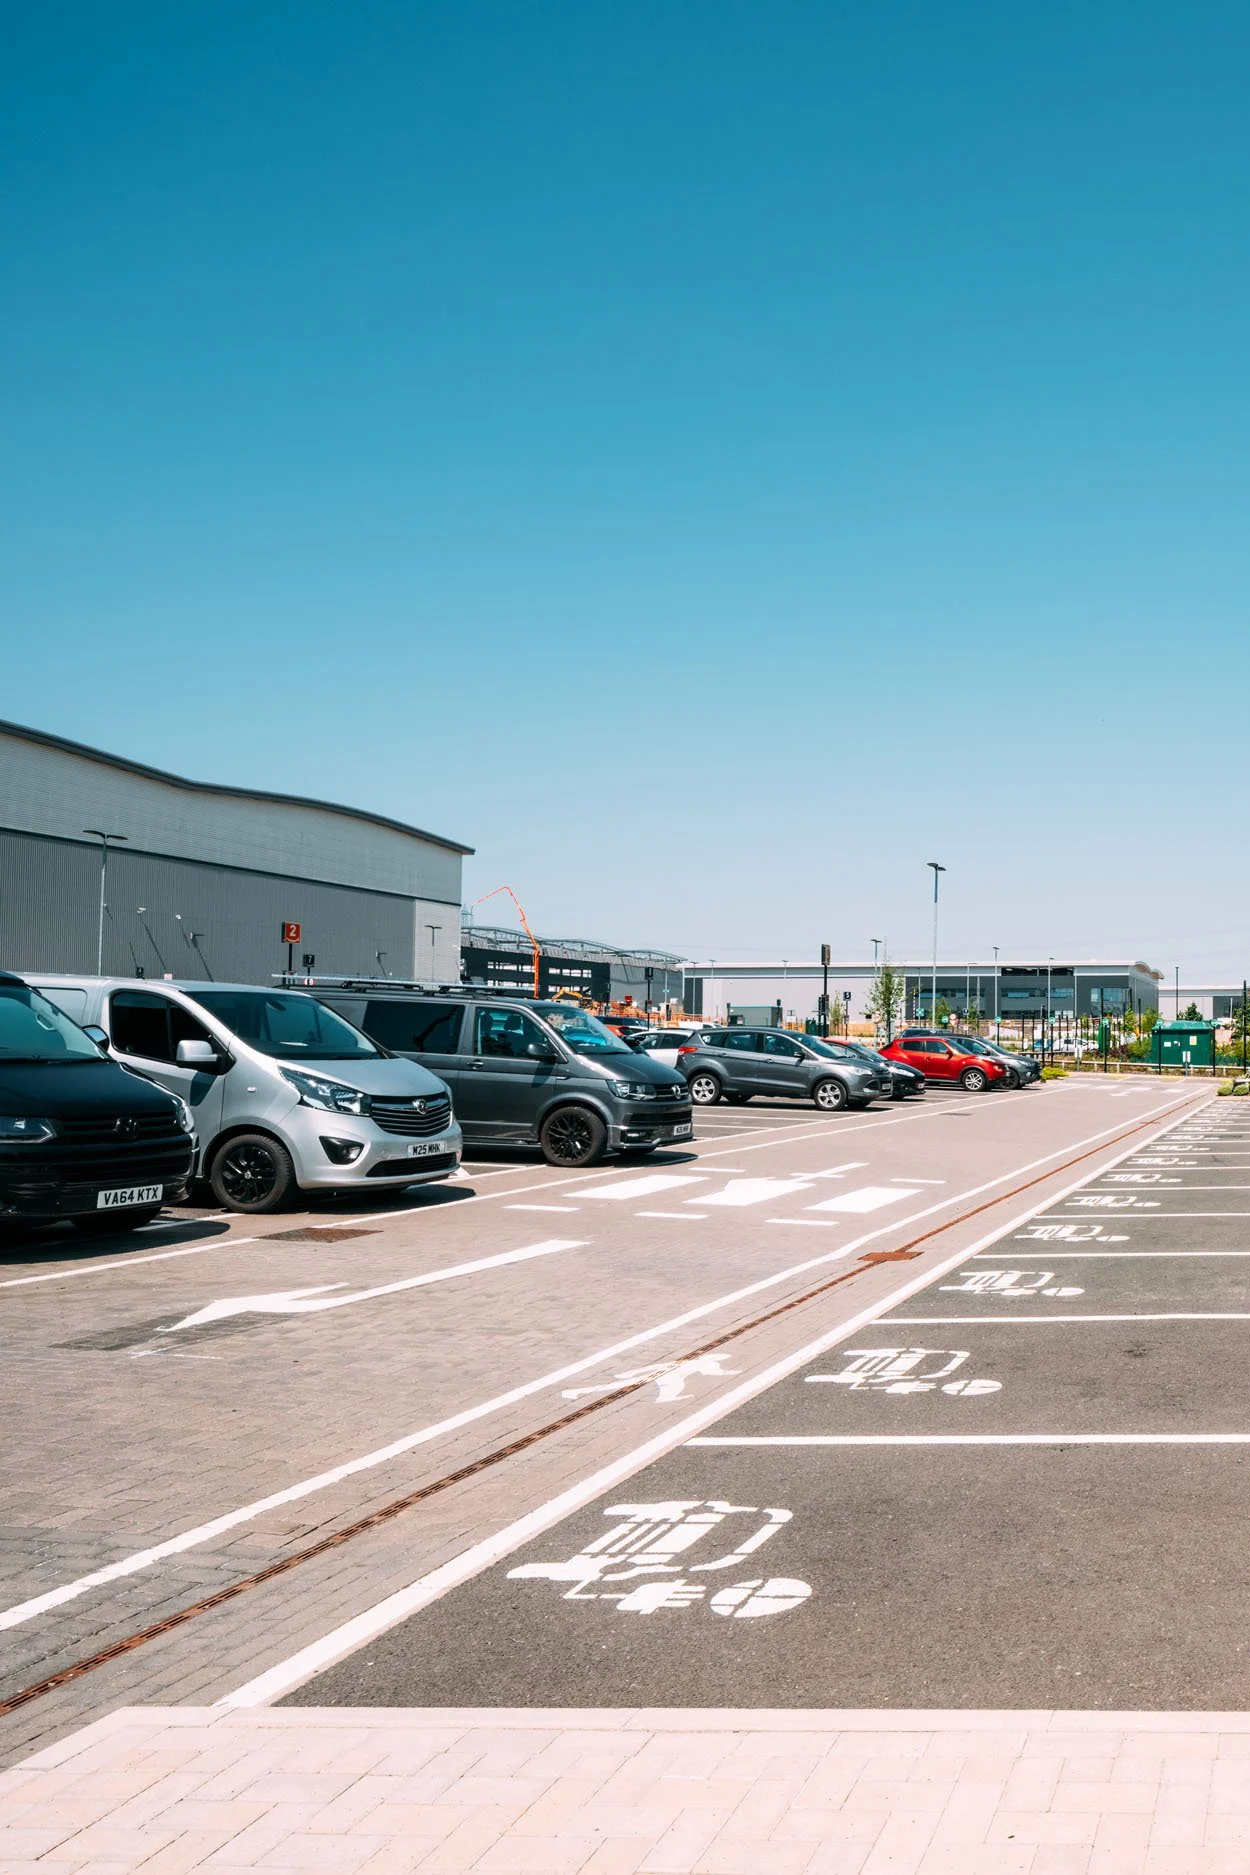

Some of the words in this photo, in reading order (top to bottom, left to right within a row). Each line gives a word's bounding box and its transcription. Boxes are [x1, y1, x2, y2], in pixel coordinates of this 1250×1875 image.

[290, 925, 296, 936] 2
[412, 1144, 427, 1156] M25
[428, 1143, 440, 1154] MHK
[104, 1190, 134, 1205] VA64
[137, 1187, 159, 1201] KTX
